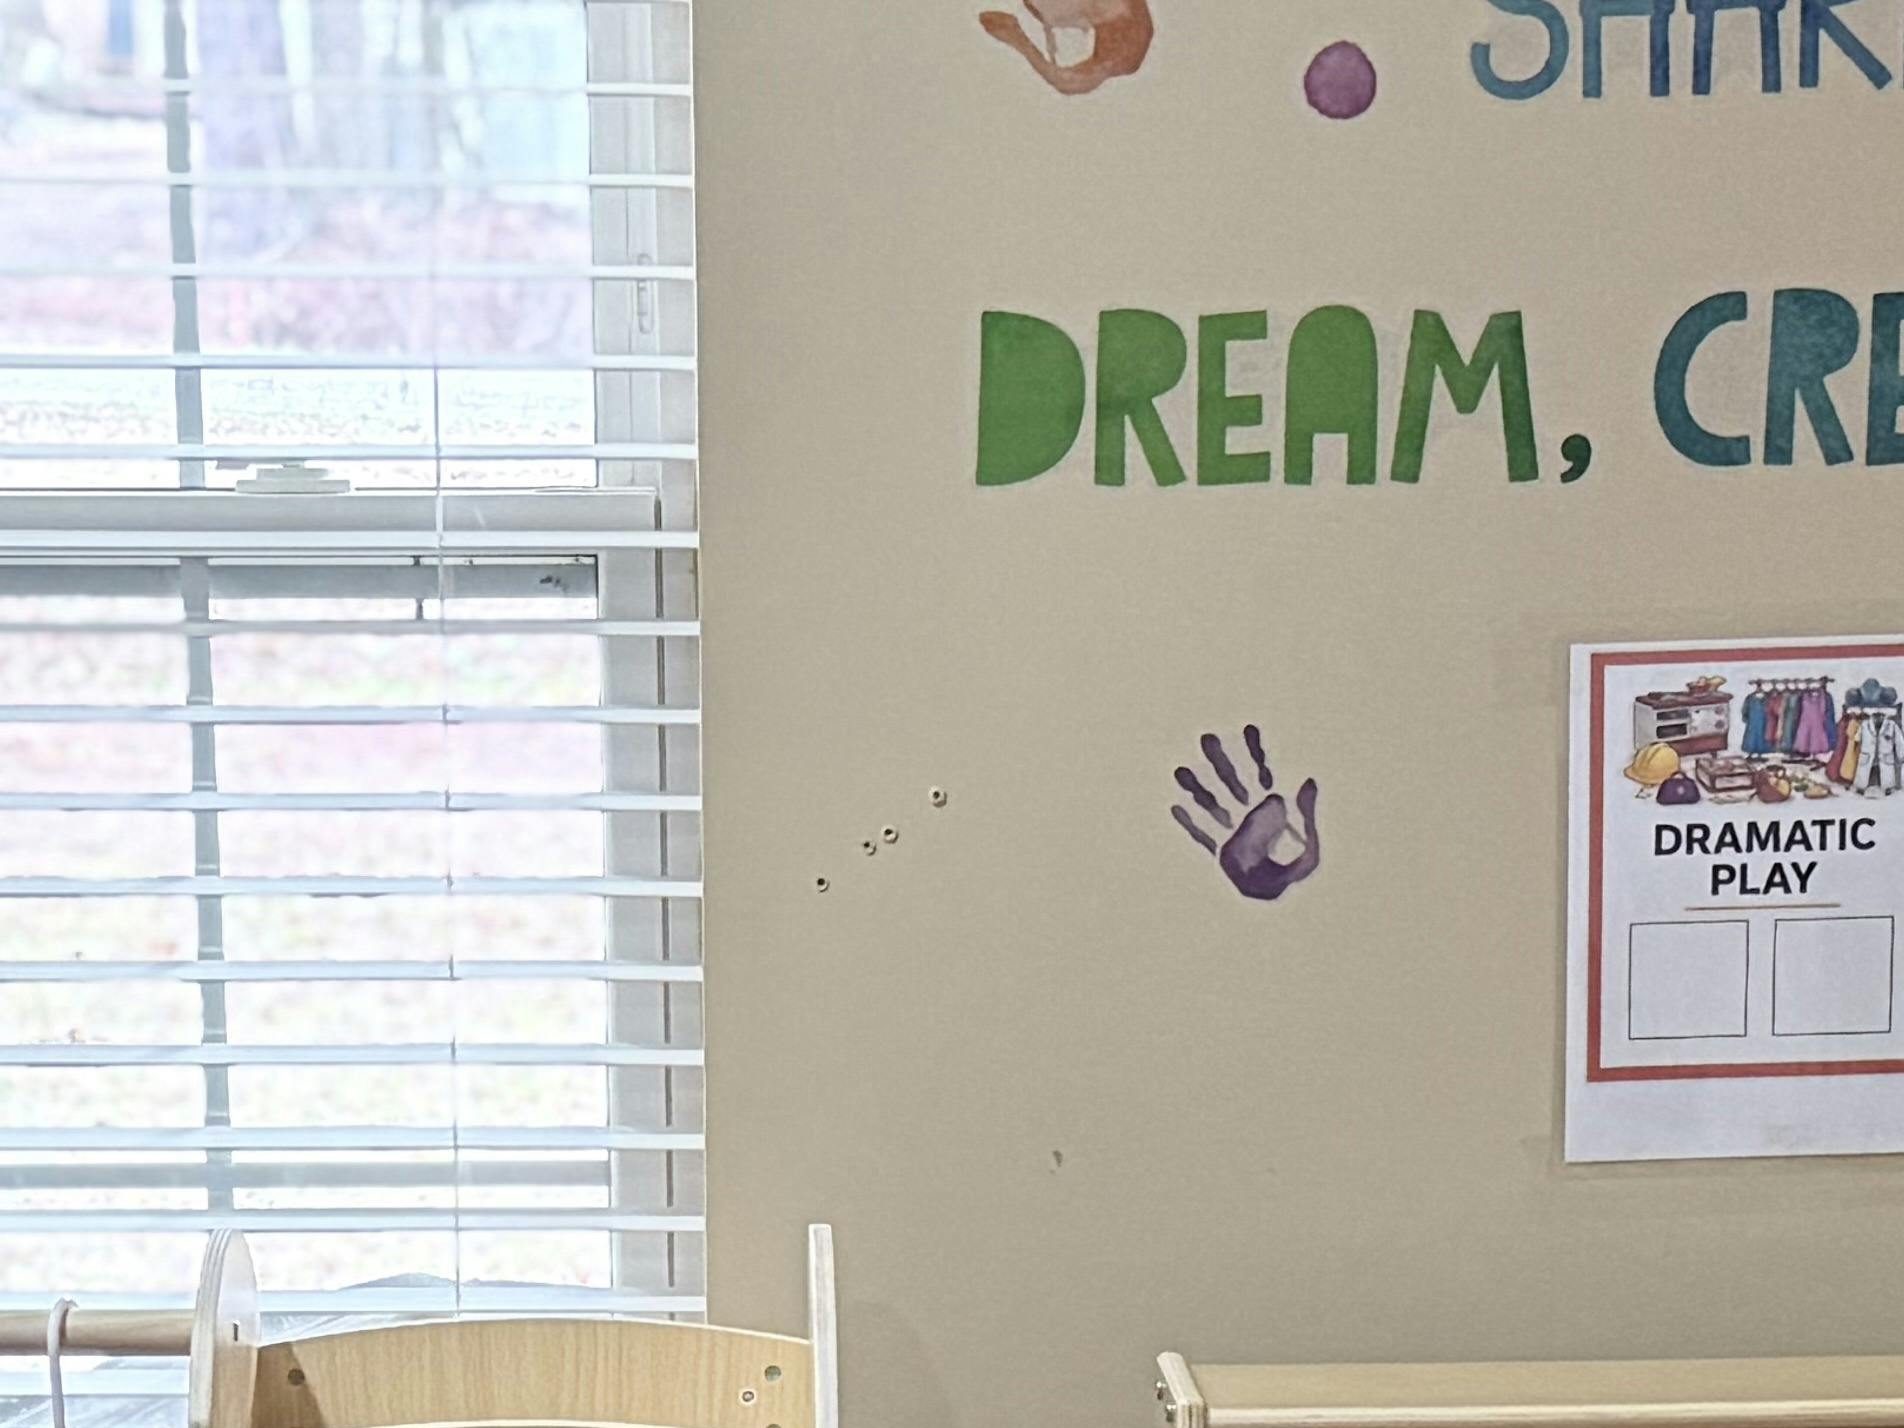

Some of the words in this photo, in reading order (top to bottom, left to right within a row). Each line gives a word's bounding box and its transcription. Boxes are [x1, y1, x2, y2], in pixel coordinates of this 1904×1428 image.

[976, 304, 1592, 487] DREAM,
[1653, 816, 1877, 857] DRAMATIC
[1709, 860, 1818, 896] PLAY
